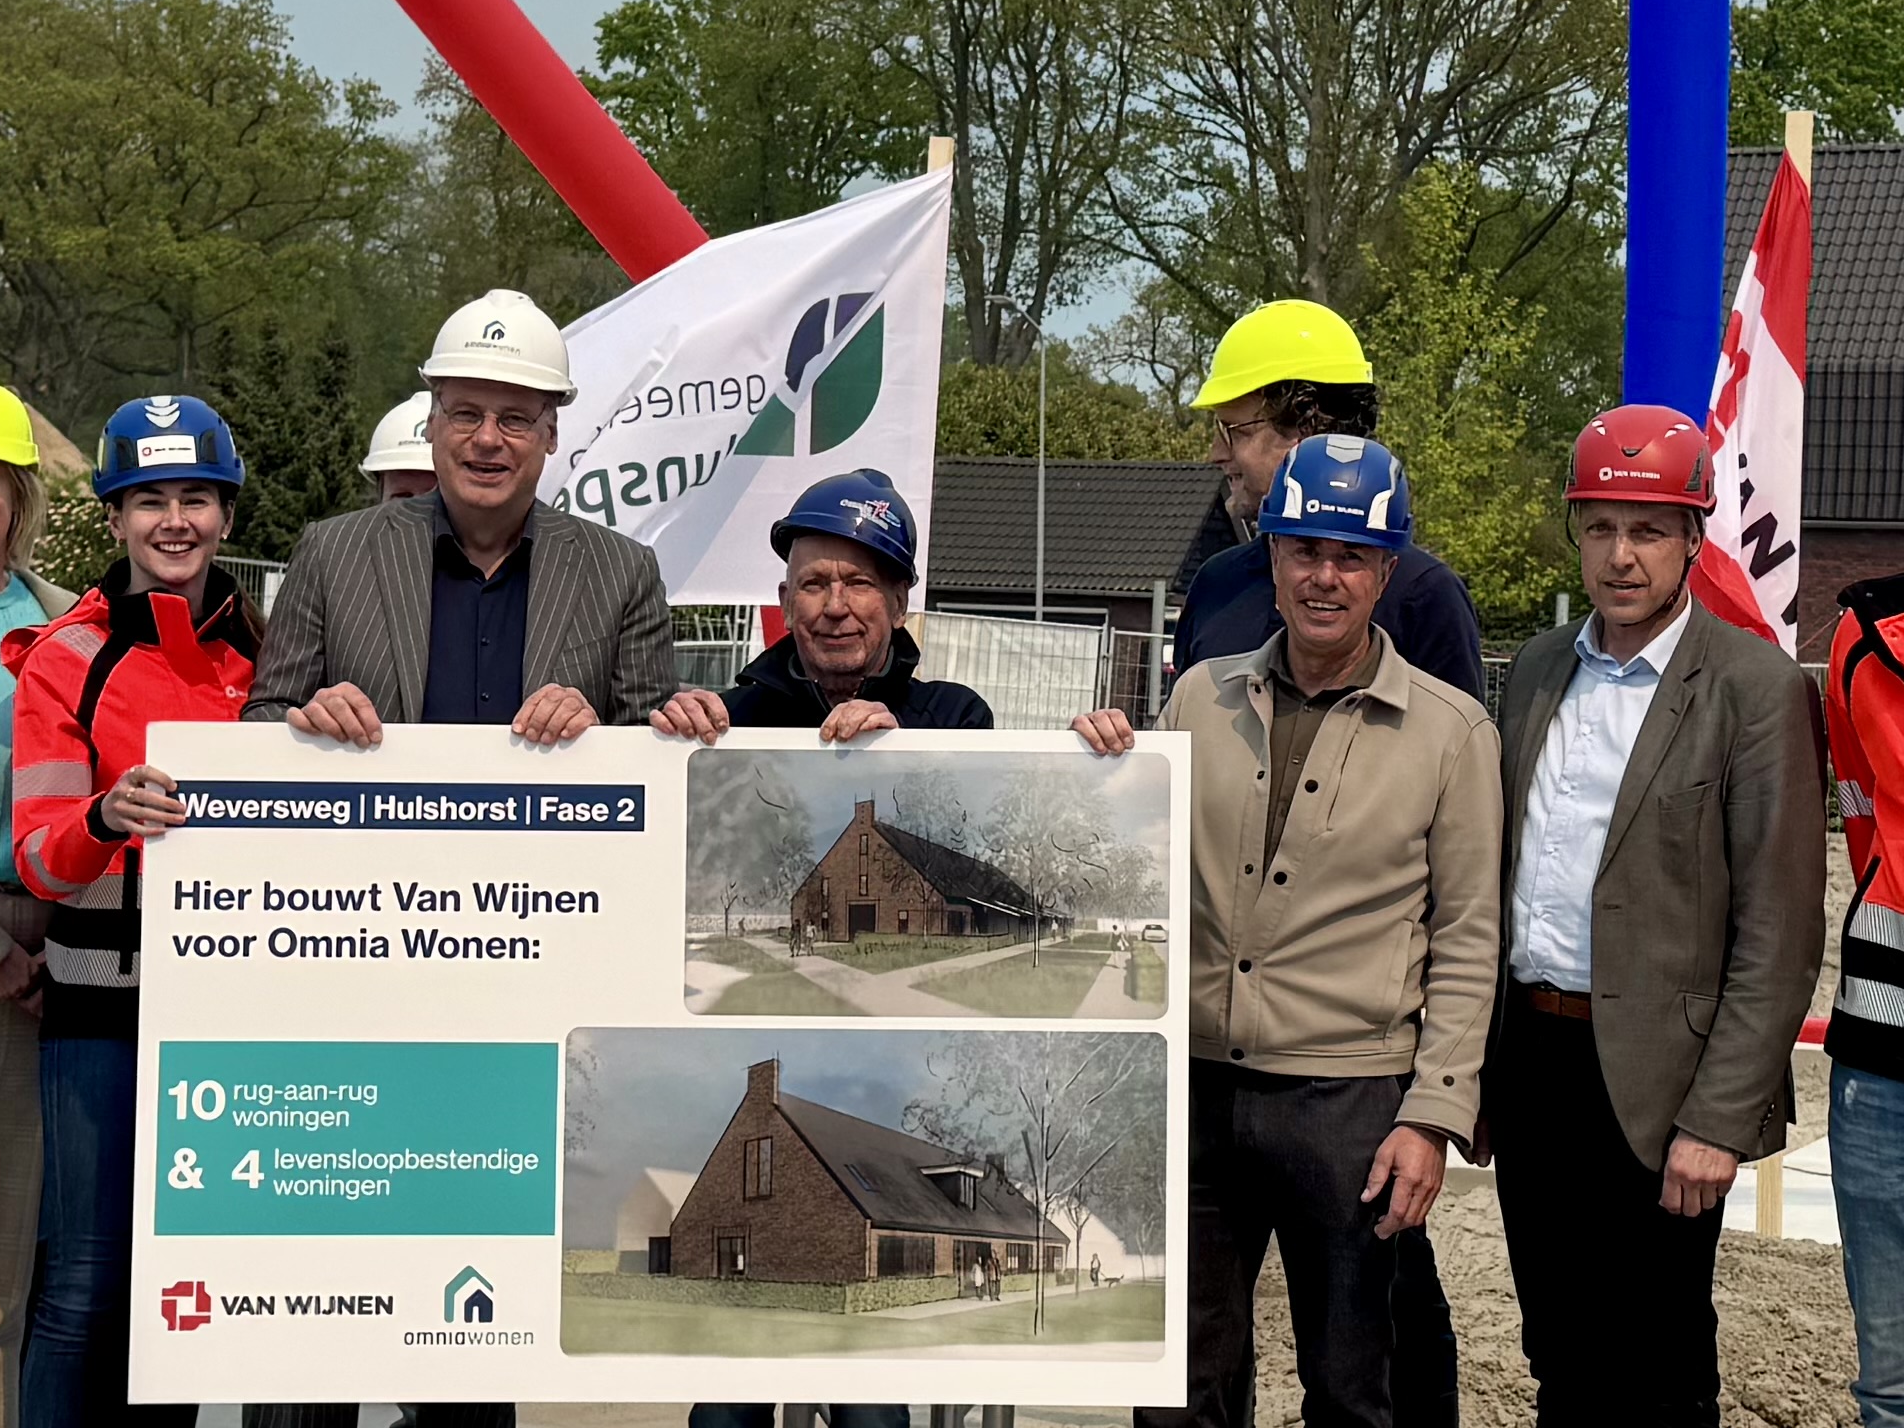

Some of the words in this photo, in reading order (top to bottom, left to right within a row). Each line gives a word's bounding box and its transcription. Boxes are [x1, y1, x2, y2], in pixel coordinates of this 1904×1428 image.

[179, 793, 352, 826] Weversweg
[373, 794, 519, 822] Hulshorst
[540, 796, 610, 823] Fase
[616, 797, 636, 823] 2
[173, 879, 253, 912] Hier
[262, 880, 383, 913] bouwt
[392, 881, 462, 913] Van
[472, 882, 600, 920] Wijnen
[172, 934, 258, 959] voor
[267, 927, 391, 960] Omnia
[400, 928, 541, 961] Wonen:
[167, 1079, 227, 1122] 10
[232, 1084, 379, 1106] rug-aan-rug
[232, 1104, 351, 1132] woningen
[166, 1146, 206, 1190] &
[231, 1148, 266, 1190] 4
[273, 1147, 540, 1176] levensloopbestendige
[273, 1174, 391, 1201] woningen
[219, 1294, 276, 1316] VAN
[284, 1294, 394, 1317] WIJNEN
